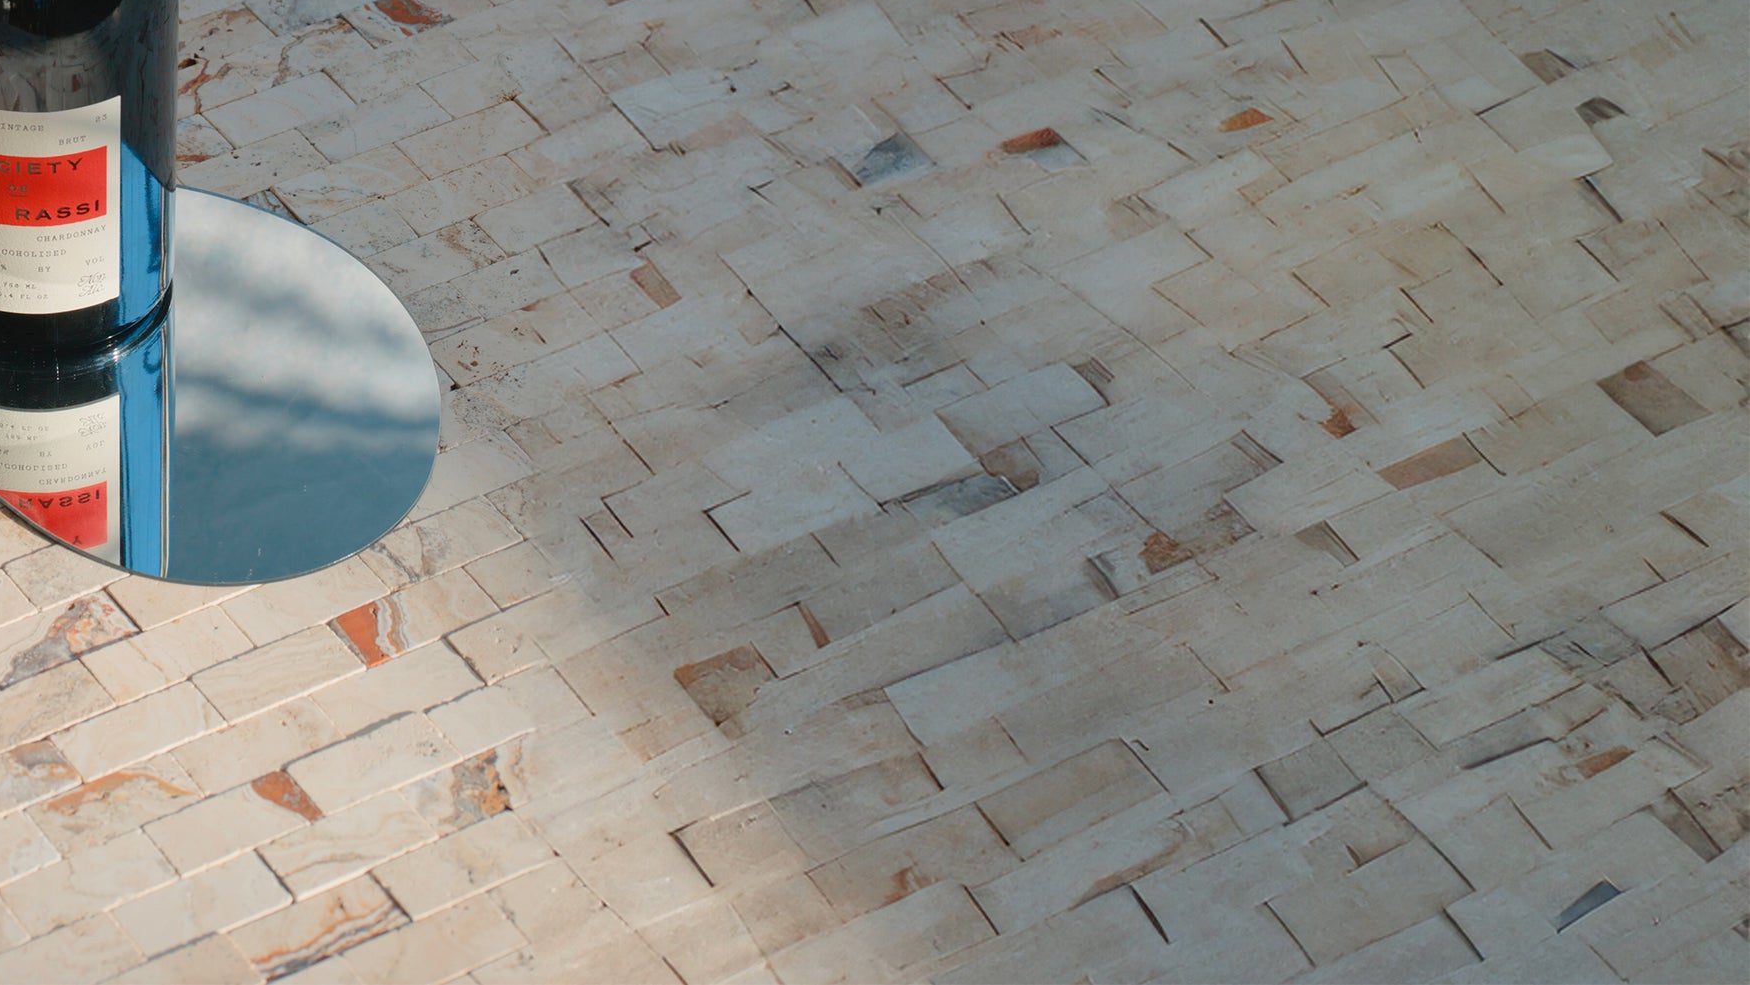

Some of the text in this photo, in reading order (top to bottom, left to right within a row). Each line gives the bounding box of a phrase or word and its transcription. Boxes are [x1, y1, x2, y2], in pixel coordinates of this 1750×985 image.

[58, 135, 87, 146] BRUT
[15, 199, 99, 220] RASSI
[36, 224, 106, 242] CHARDONNAY
[85, 256, 105, 266] VOL
